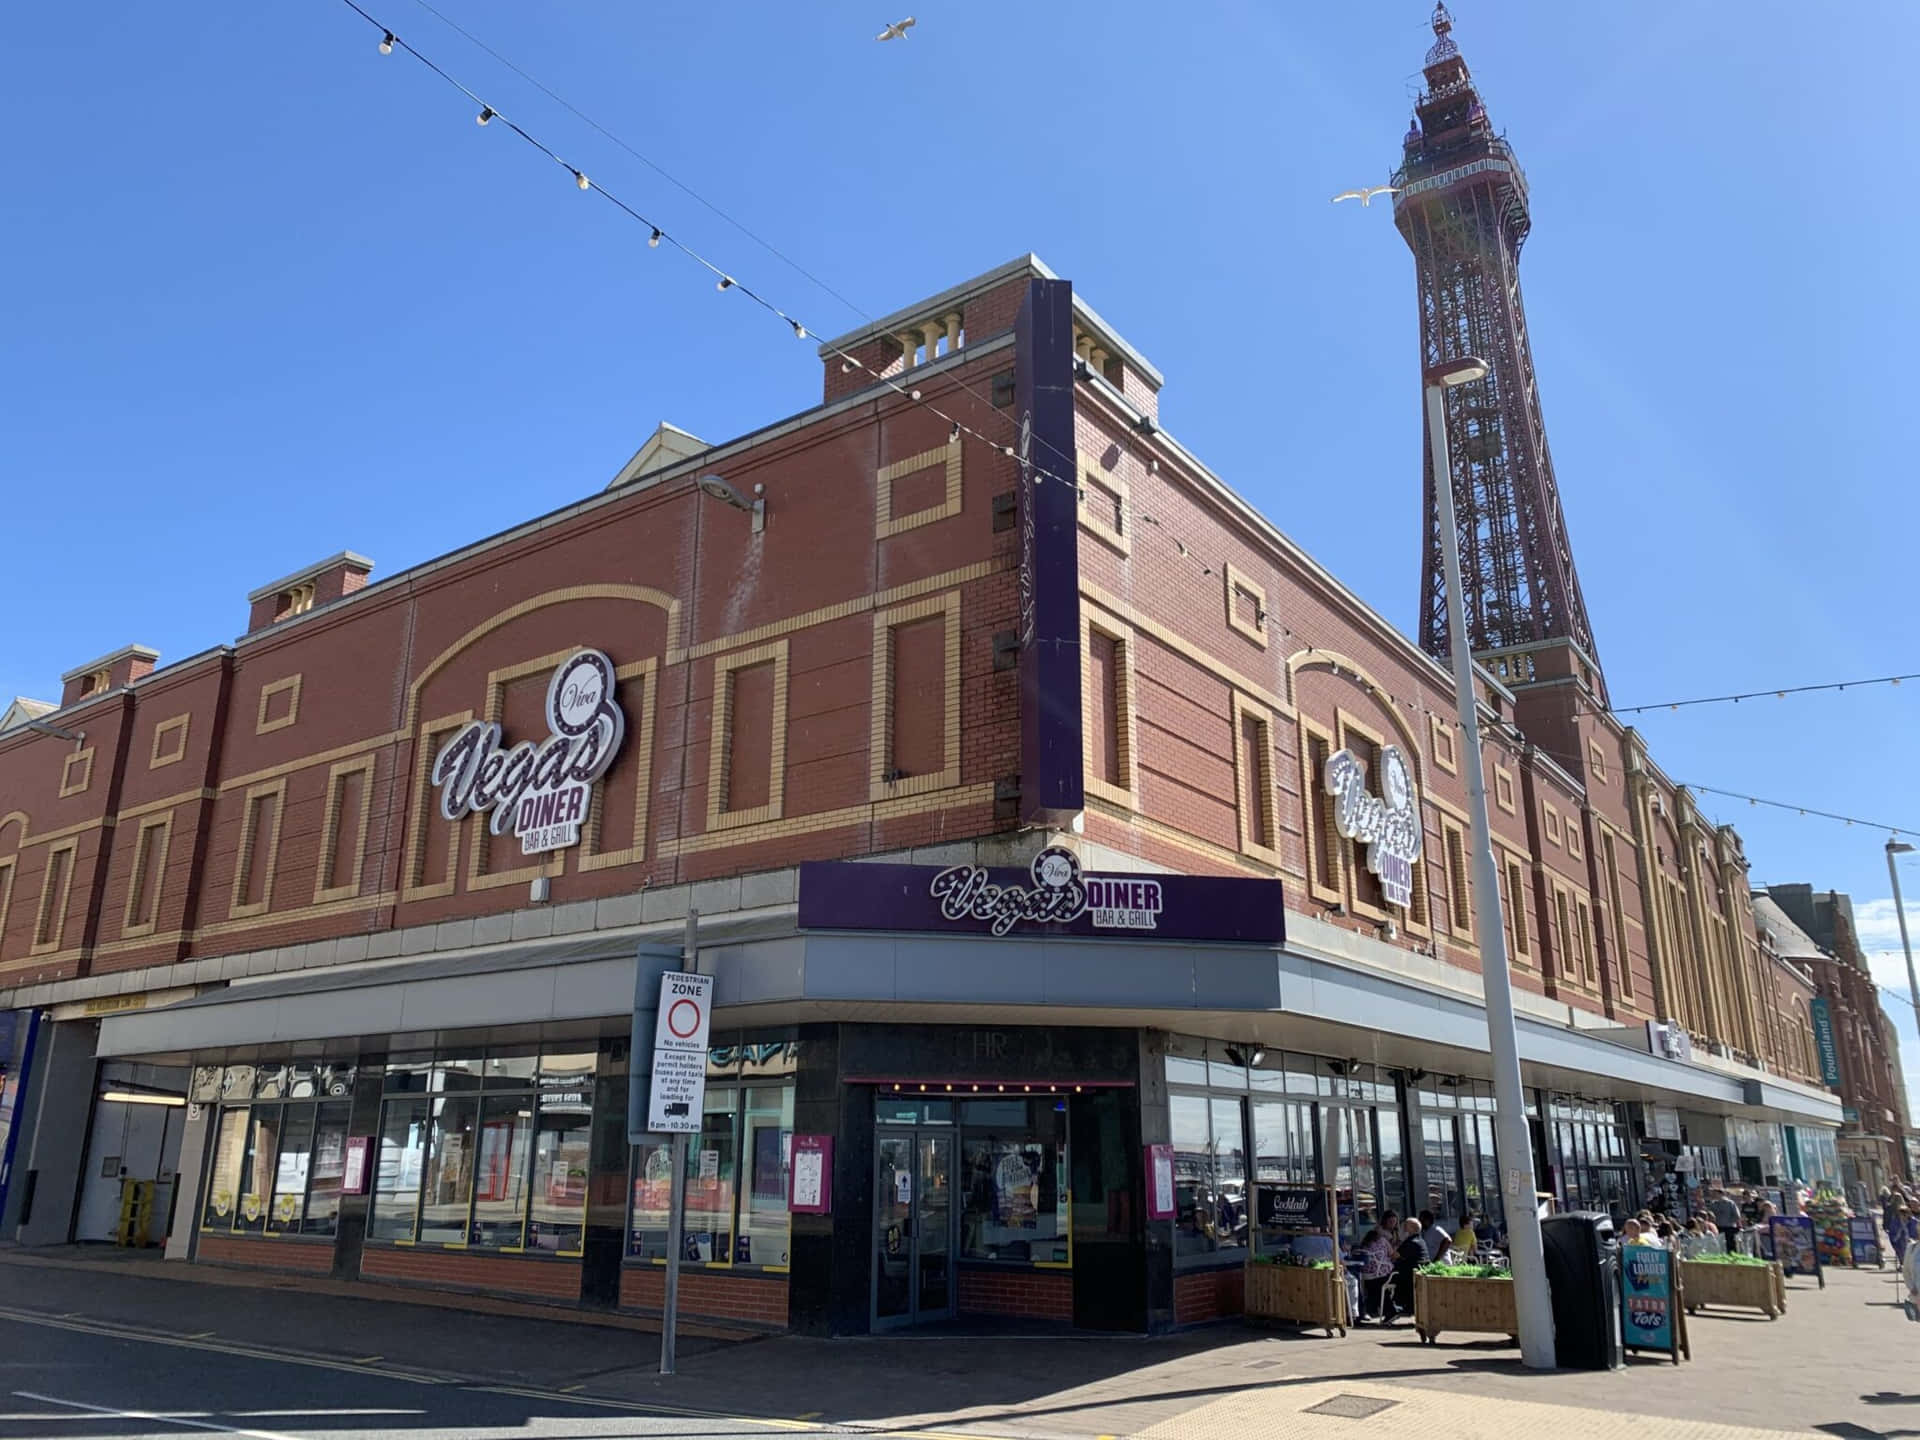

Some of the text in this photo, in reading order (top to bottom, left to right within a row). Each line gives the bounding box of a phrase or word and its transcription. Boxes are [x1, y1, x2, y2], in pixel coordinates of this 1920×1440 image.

[562, 674, 598, 713] Viva
[433, 698, 620, 835] Vegas
[518, 786, 585, 832] DINER
[524, 824, 572, 851] BAR & GRILL
[932, 865, 1086, 935] Vegas
[1087, 881, 1160, 909] DINER
[1096, 910, 1154, 926] BAR & GRILL
[667, 974, 709, 984] PEDESTRIAN
[672, 984, 702, 996] ZONE
[675, 1041, 700, 1049] vehicles
[1820, 1020, 1838, 1080] Poundland
[664, 1053, 685, 1061] Except
[1273, 1195, 1309, 1211] Cocktails
[1636, 1252, 1660, 1263] FULLY
[1633, 1263, 1666, 1274] LOADED
[1634, 1311, 1661, 1326] Tots
